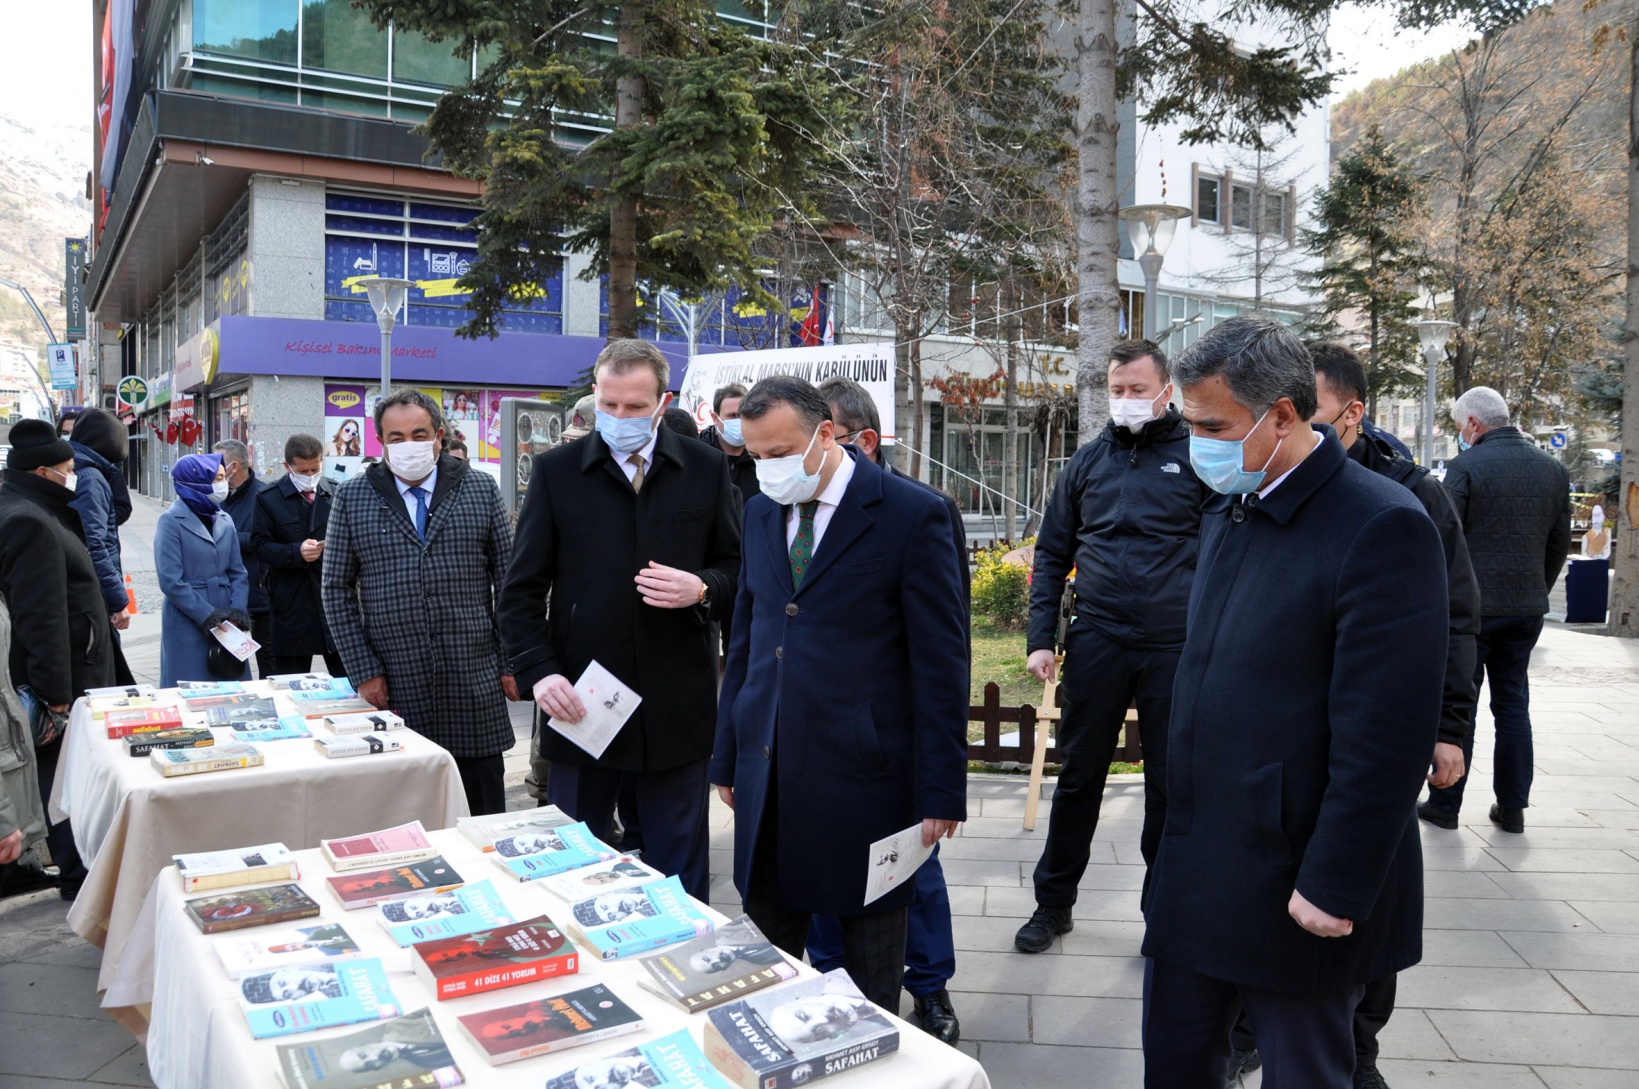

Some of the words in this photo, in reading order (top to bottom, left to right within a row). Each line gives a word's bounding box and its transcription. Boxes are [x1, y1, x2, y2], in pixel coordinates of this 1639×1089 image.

[284, 340, 332, 356] Kişisel
[815, 354, 888, 383] KABÜLÜNÜN
[1040, 354, 1070, 376] T.C.
[331, 393, 357, 403] gratis
[132, 725, 161, 733] safahat
[474, 977, 483, 987] 41
[484, 974, 501, 984] DİZE
[502, 973, 511, 982] 41
[511, 967, 537, 980] YORUM
[728, 1010, 782, 1063] SAFAHAT
[656, 1043, 709, 1089] AFAHAT
[825, 1049, 848, 1062] MEHMET
[825, 1046, 880, 1076] SAFAHAT
